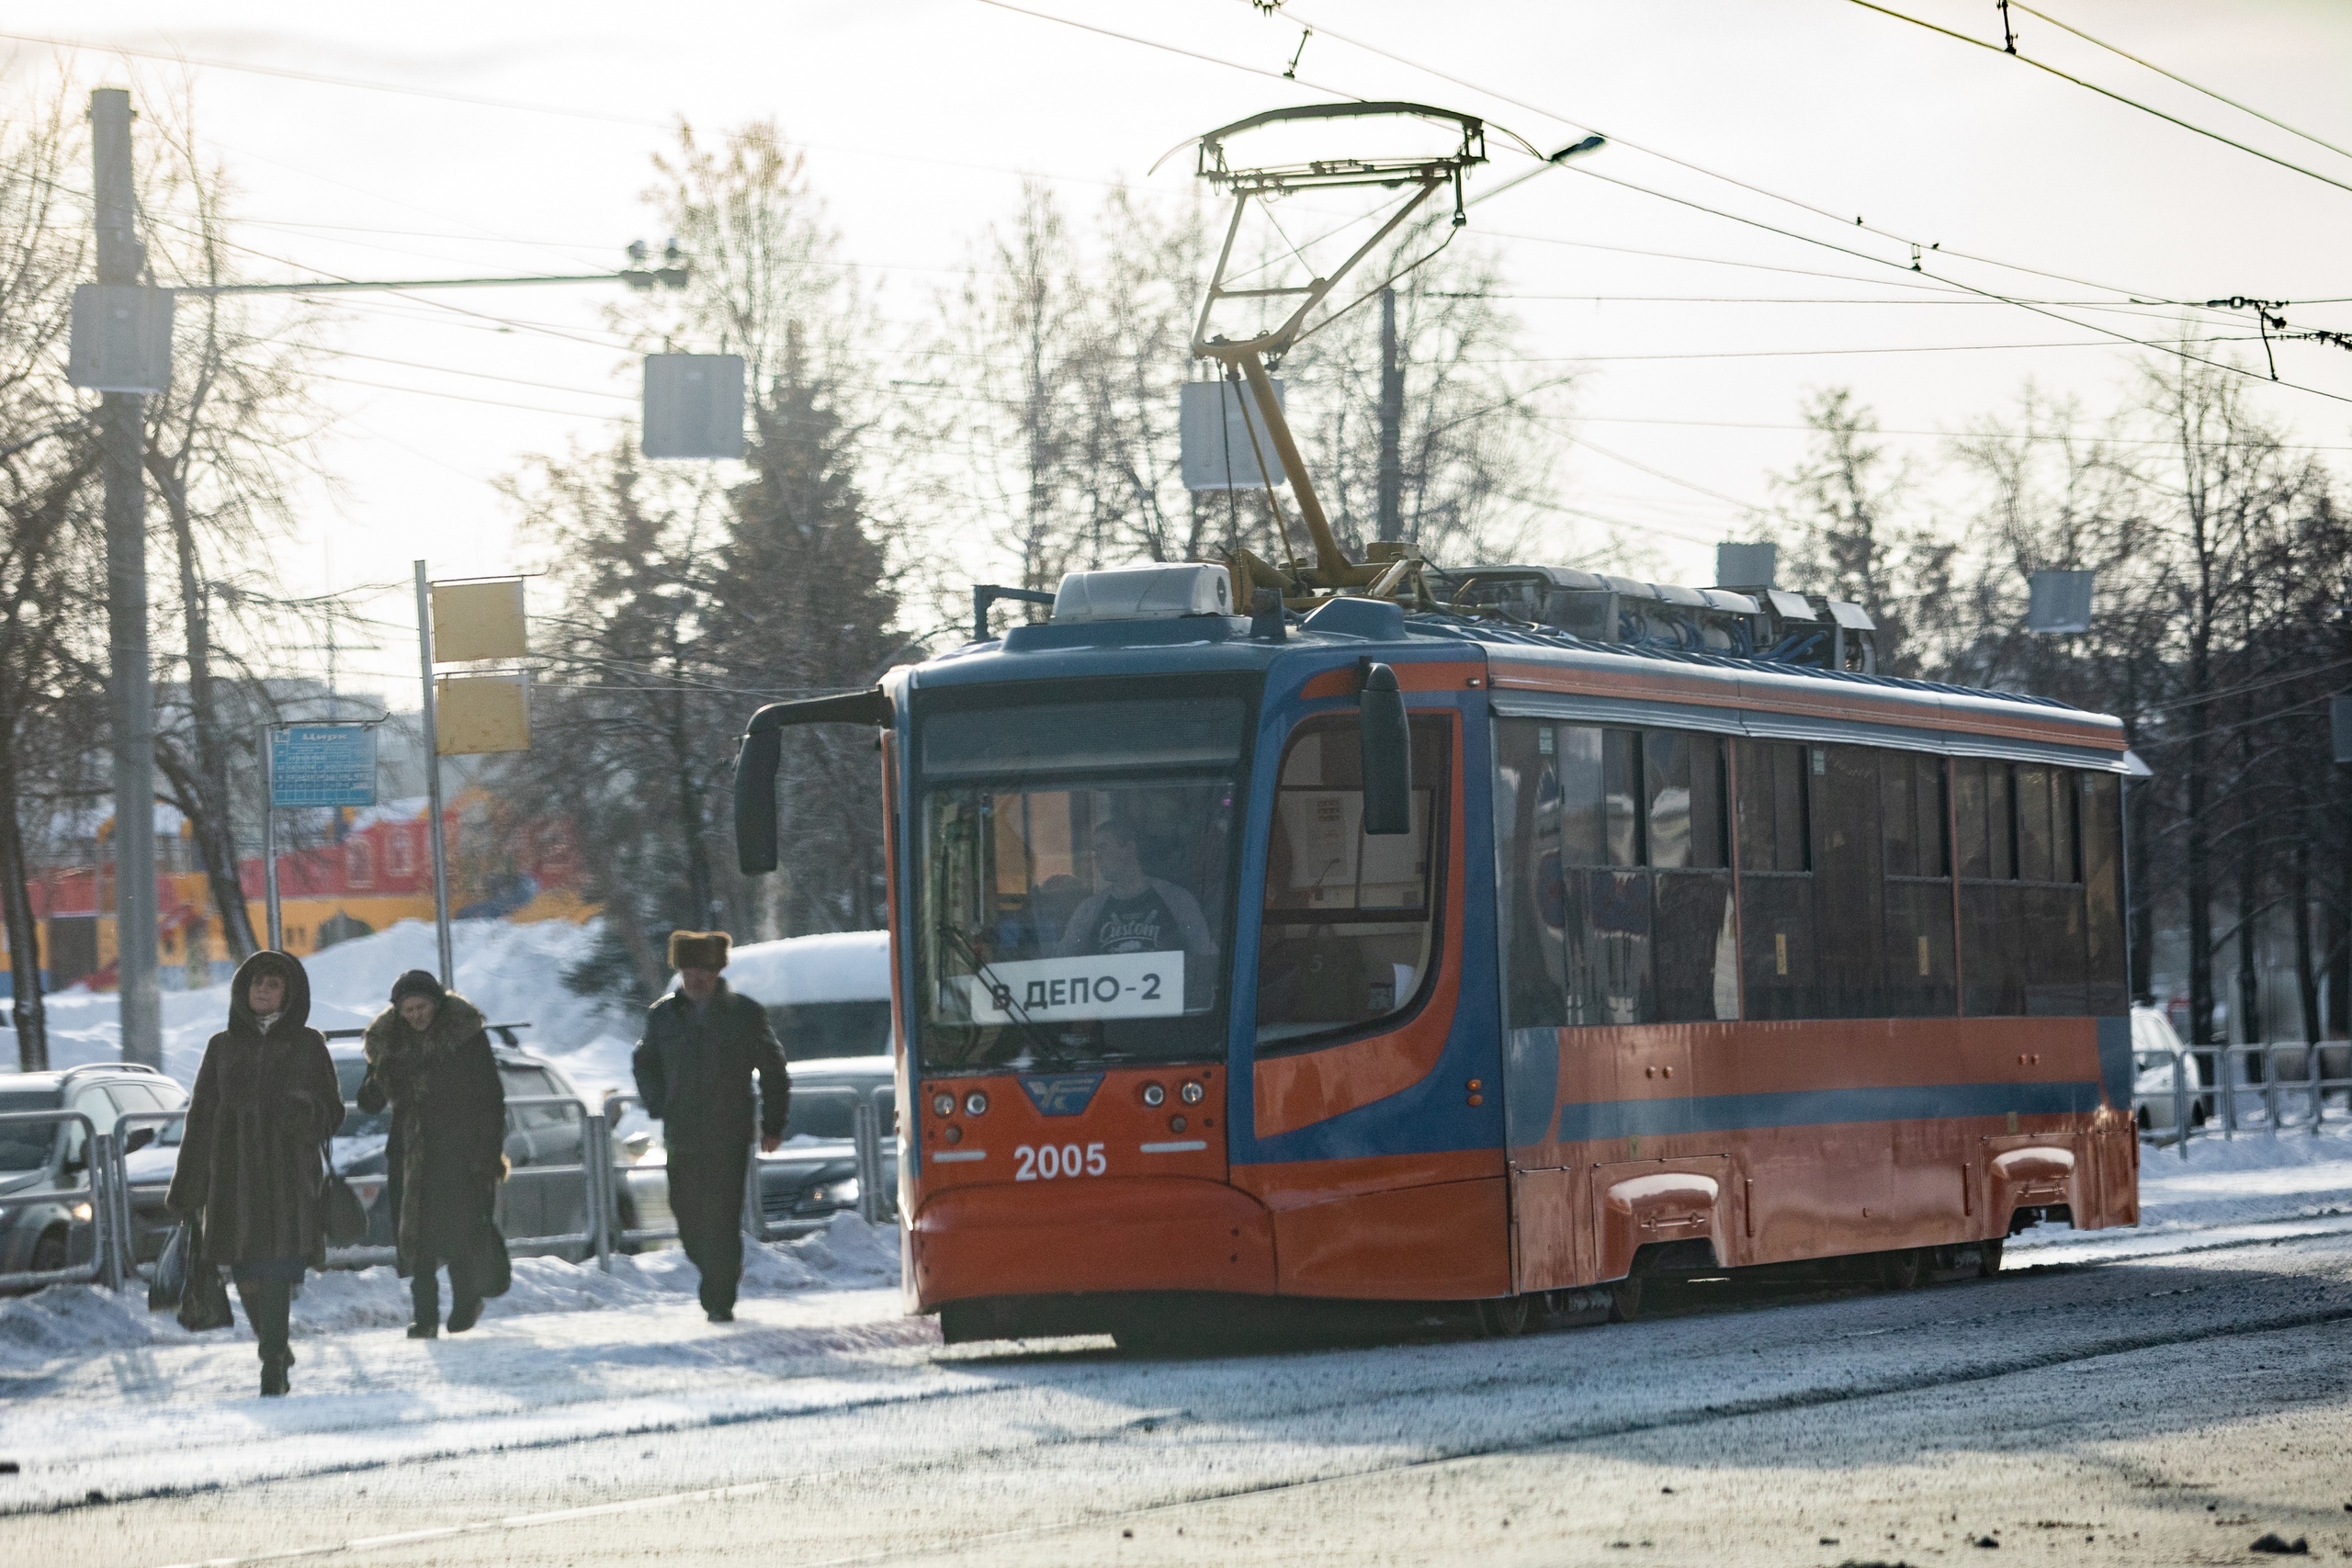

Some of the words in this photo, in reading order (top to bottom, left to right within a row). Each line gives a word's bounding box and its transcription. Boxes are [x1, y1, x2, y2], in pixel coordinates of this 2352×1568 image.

[303, 733, 347, 741] Цирк
[1100, 920, 1160, 947] Custom
[1023, 973, 1160, 1011] ДЕПО-2
[1013, 1142, 1107, 1182] 2005
